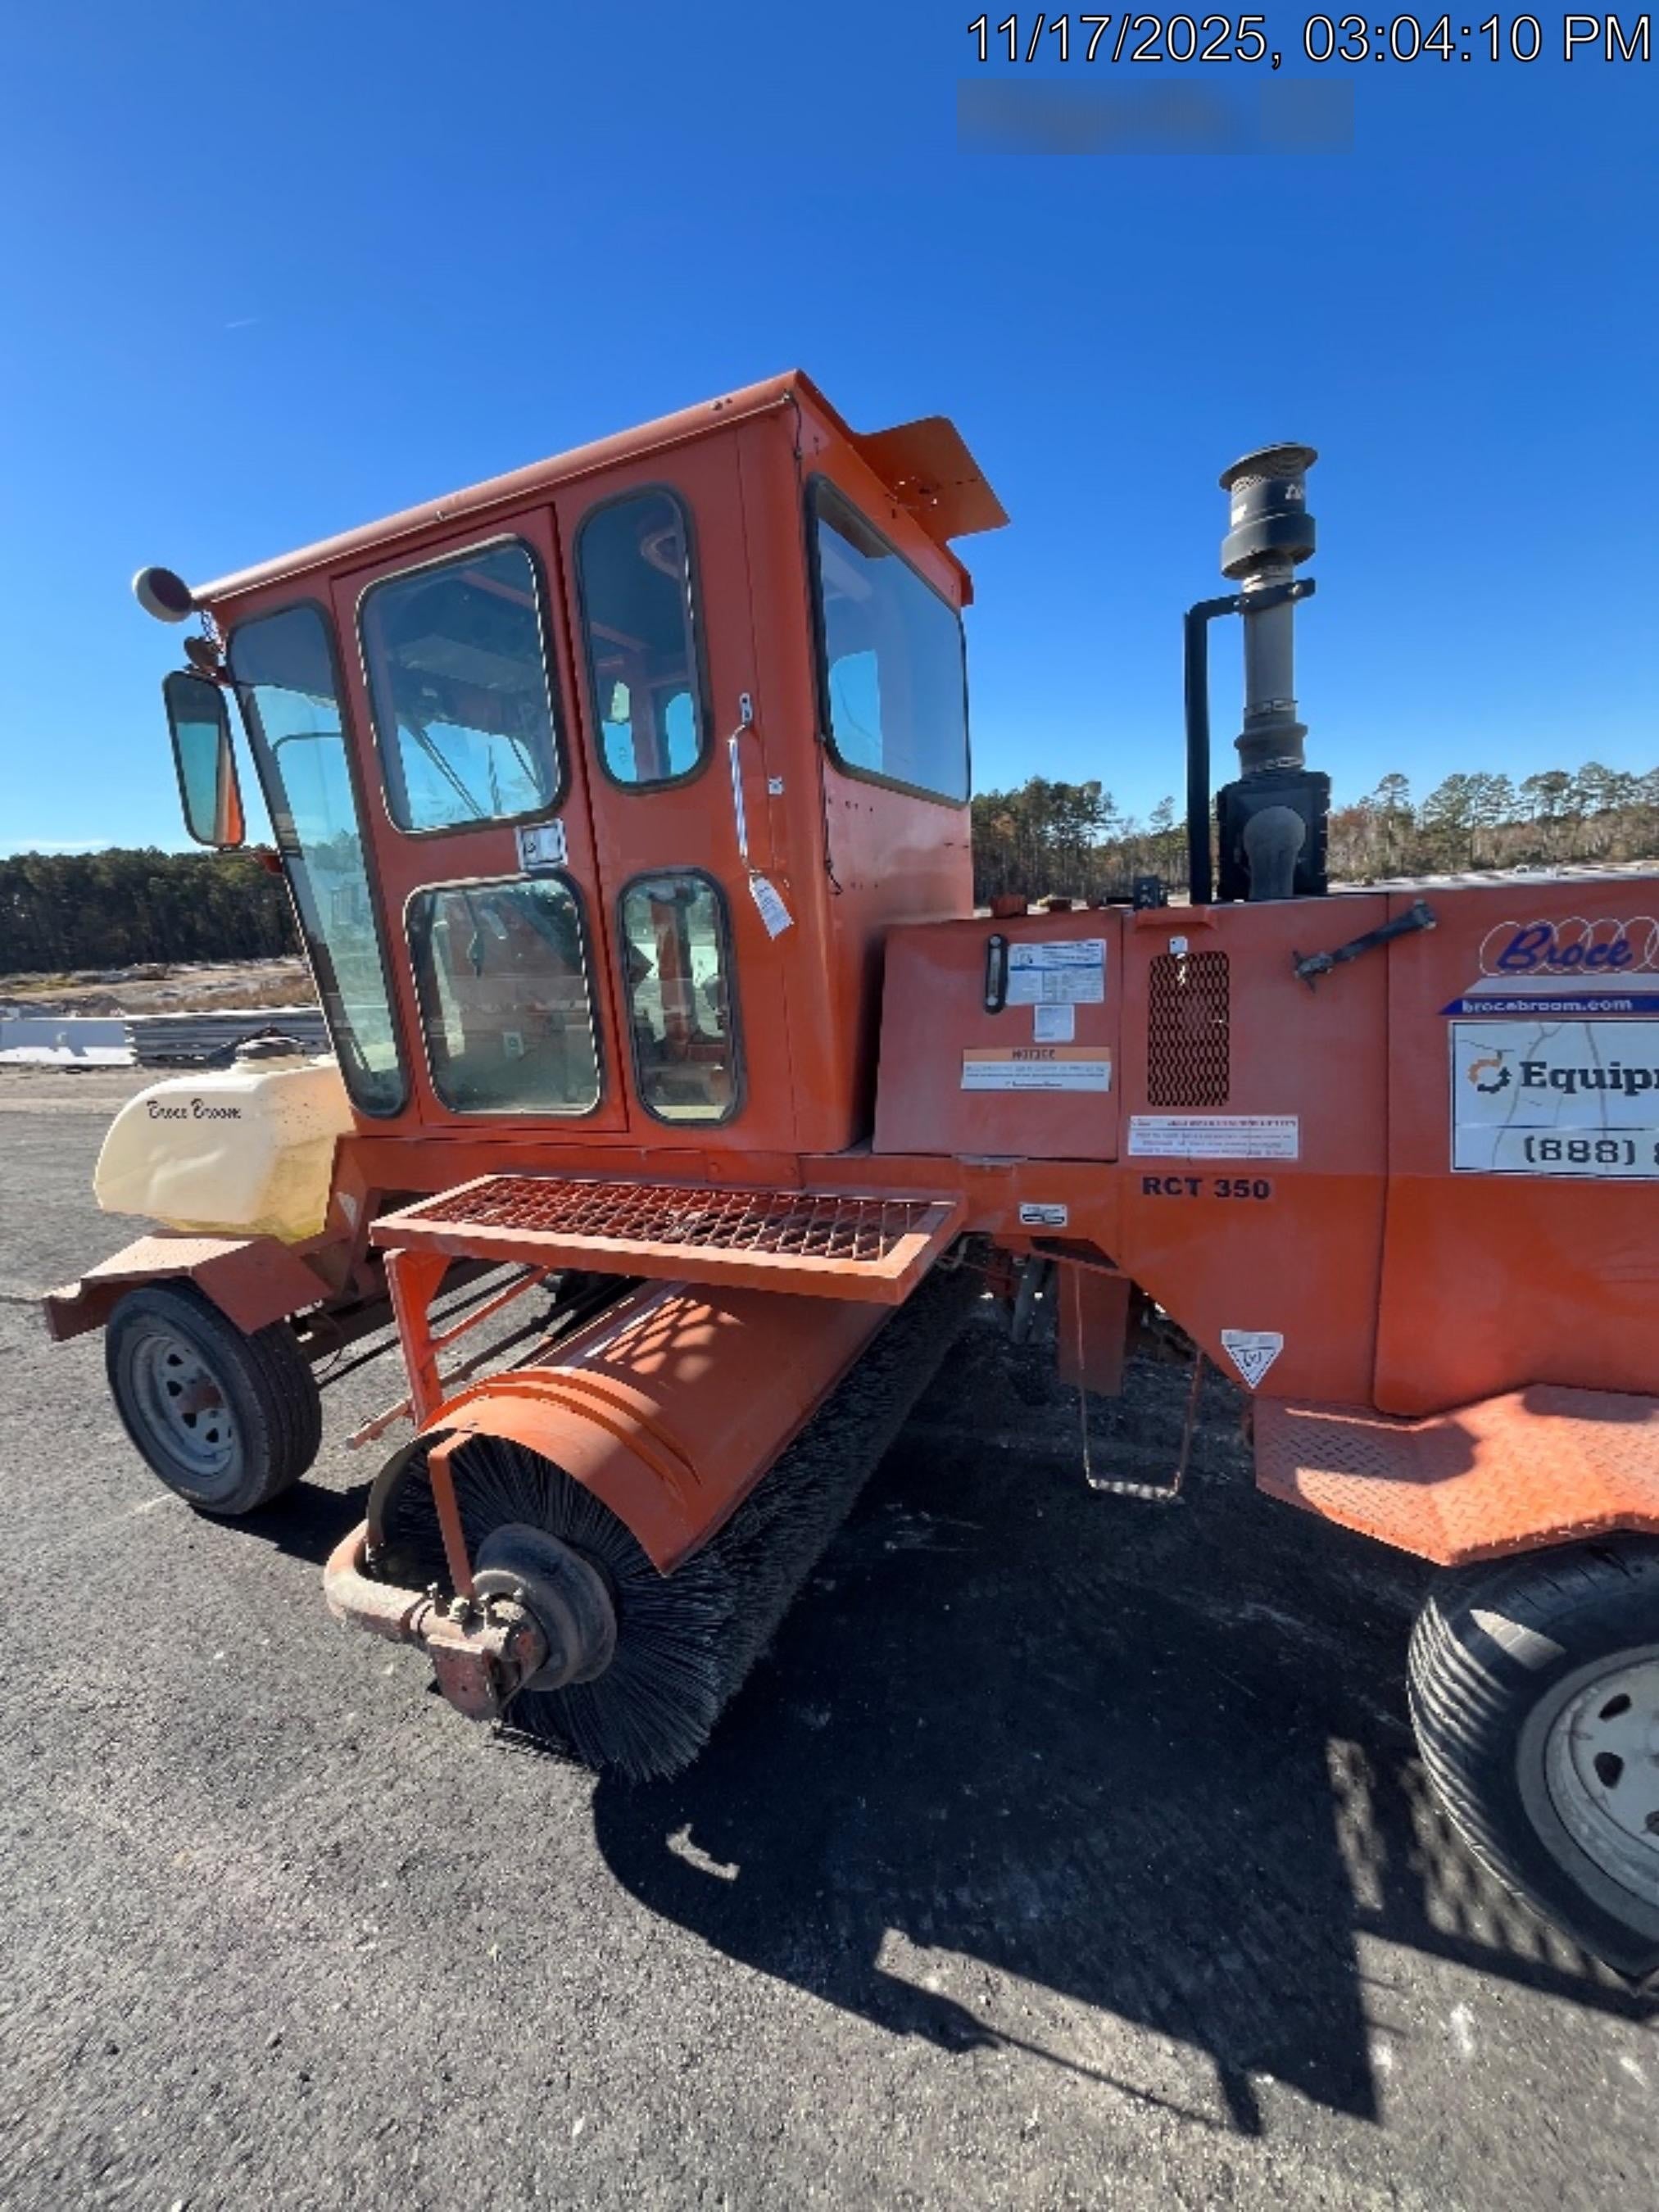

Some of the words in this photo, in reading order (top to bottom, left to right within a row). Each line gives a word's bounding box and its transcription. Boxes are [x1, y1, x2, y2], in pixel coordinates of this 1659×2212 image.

[1496, 925, 1633, 970] Broce
[1462, 999, 1633, 1013] brocebroom.com
[1519, 1061, 1659, 1096] Equip
[1524, 1135, 1635, 1166] (888)
[1142, 1176, 1203, 1197] RCT
[1214, 1178, 1270, 1200] 350
